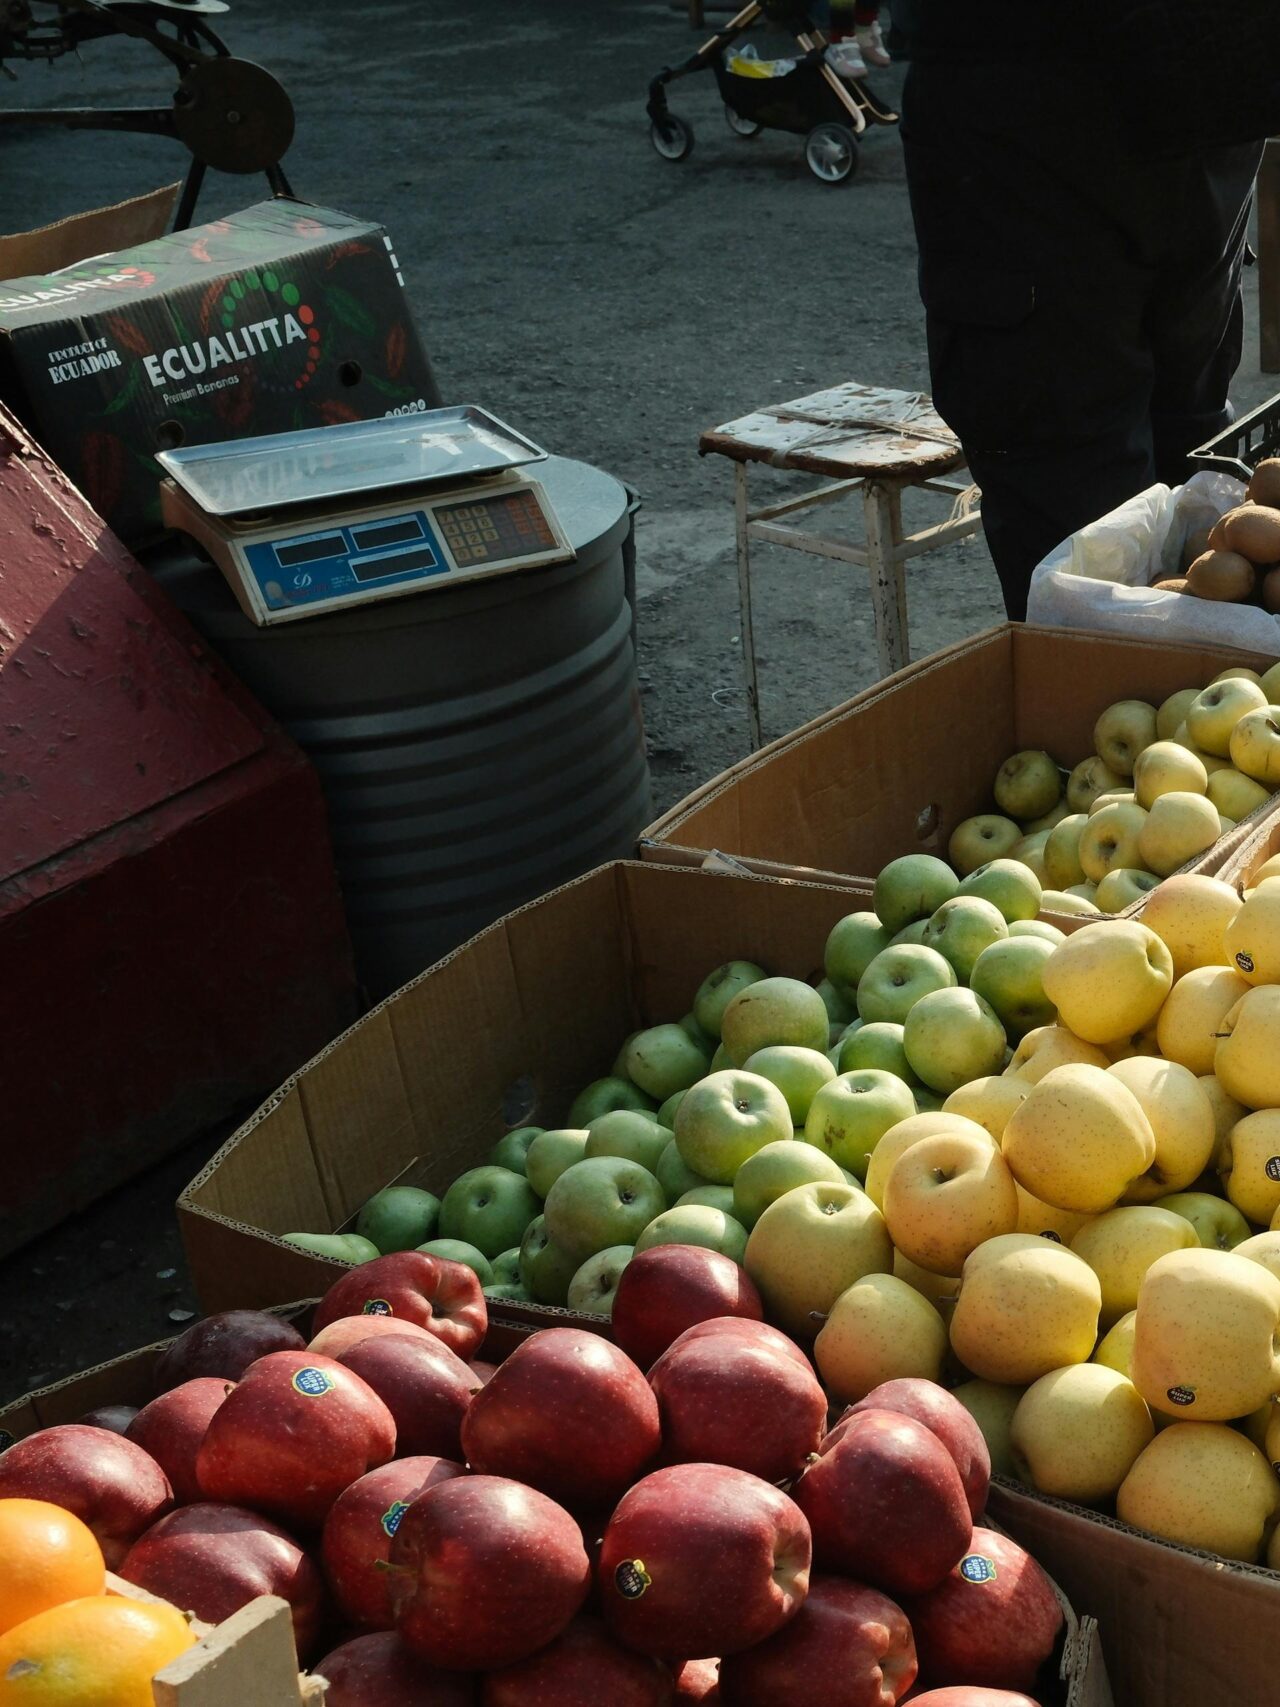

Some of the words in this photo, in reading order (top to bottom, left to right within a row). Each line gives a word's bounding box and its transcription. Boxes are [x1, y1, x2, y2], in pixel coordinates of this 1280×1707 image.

[48, 340, 96, 363] PRODUCT
[143, 313, 307, 388] ECUALITTA
[48, 350, 122, 385] ECUADOR
[163, 387, 197, 407] Premium
[196, 374, 240, 396] Bananas
[1270, 1164, 1278, 1176] LUX
[305, 1370, 320, 1392] SUPER
[1170, 1390, 1192, 1401] SUPER
[965, 1562, 975, 1576] LUX
[971, 1558, 982, 1579] SUPER
